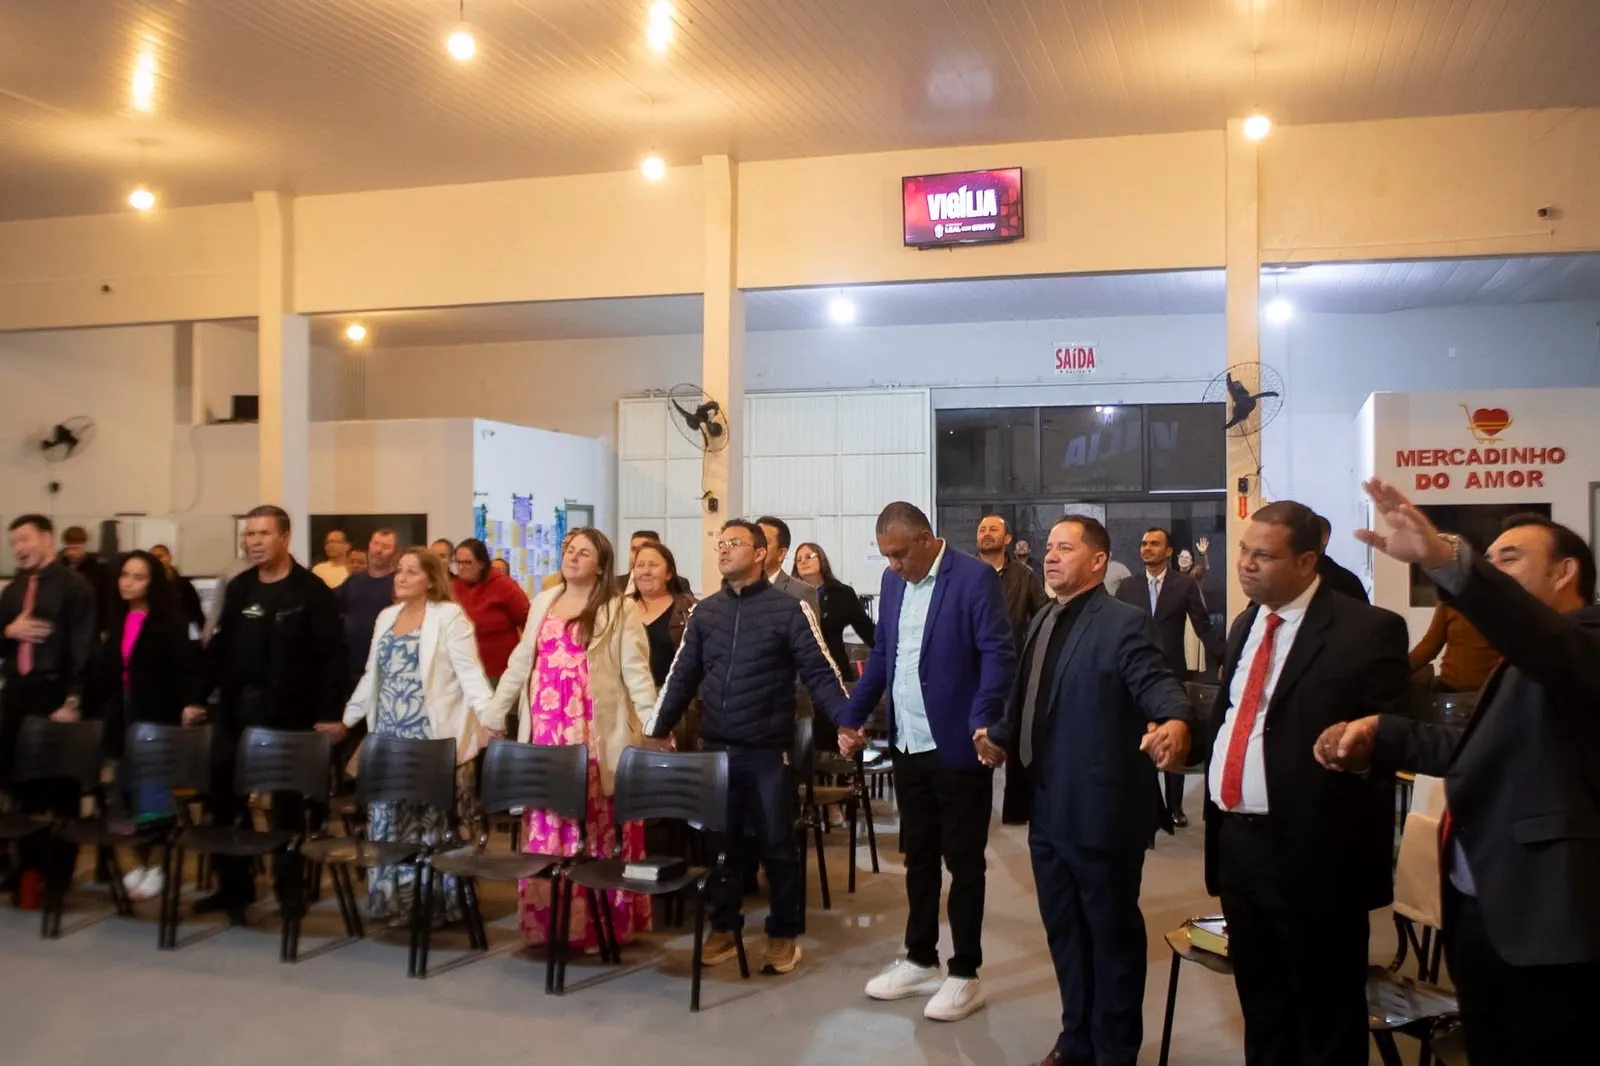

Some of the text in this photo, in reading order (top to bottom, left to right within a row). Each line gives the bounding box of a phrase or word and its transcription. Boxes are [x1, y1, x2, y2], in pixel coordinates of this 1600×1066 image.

[927, 185, 998, 221] VIGÍLIA
[1055, 347, 1095, 370] SAÍDA
[1395, 447, 1567, 468] MERCADINHO
[1415, 470, 1545, 491] DO AMOR
